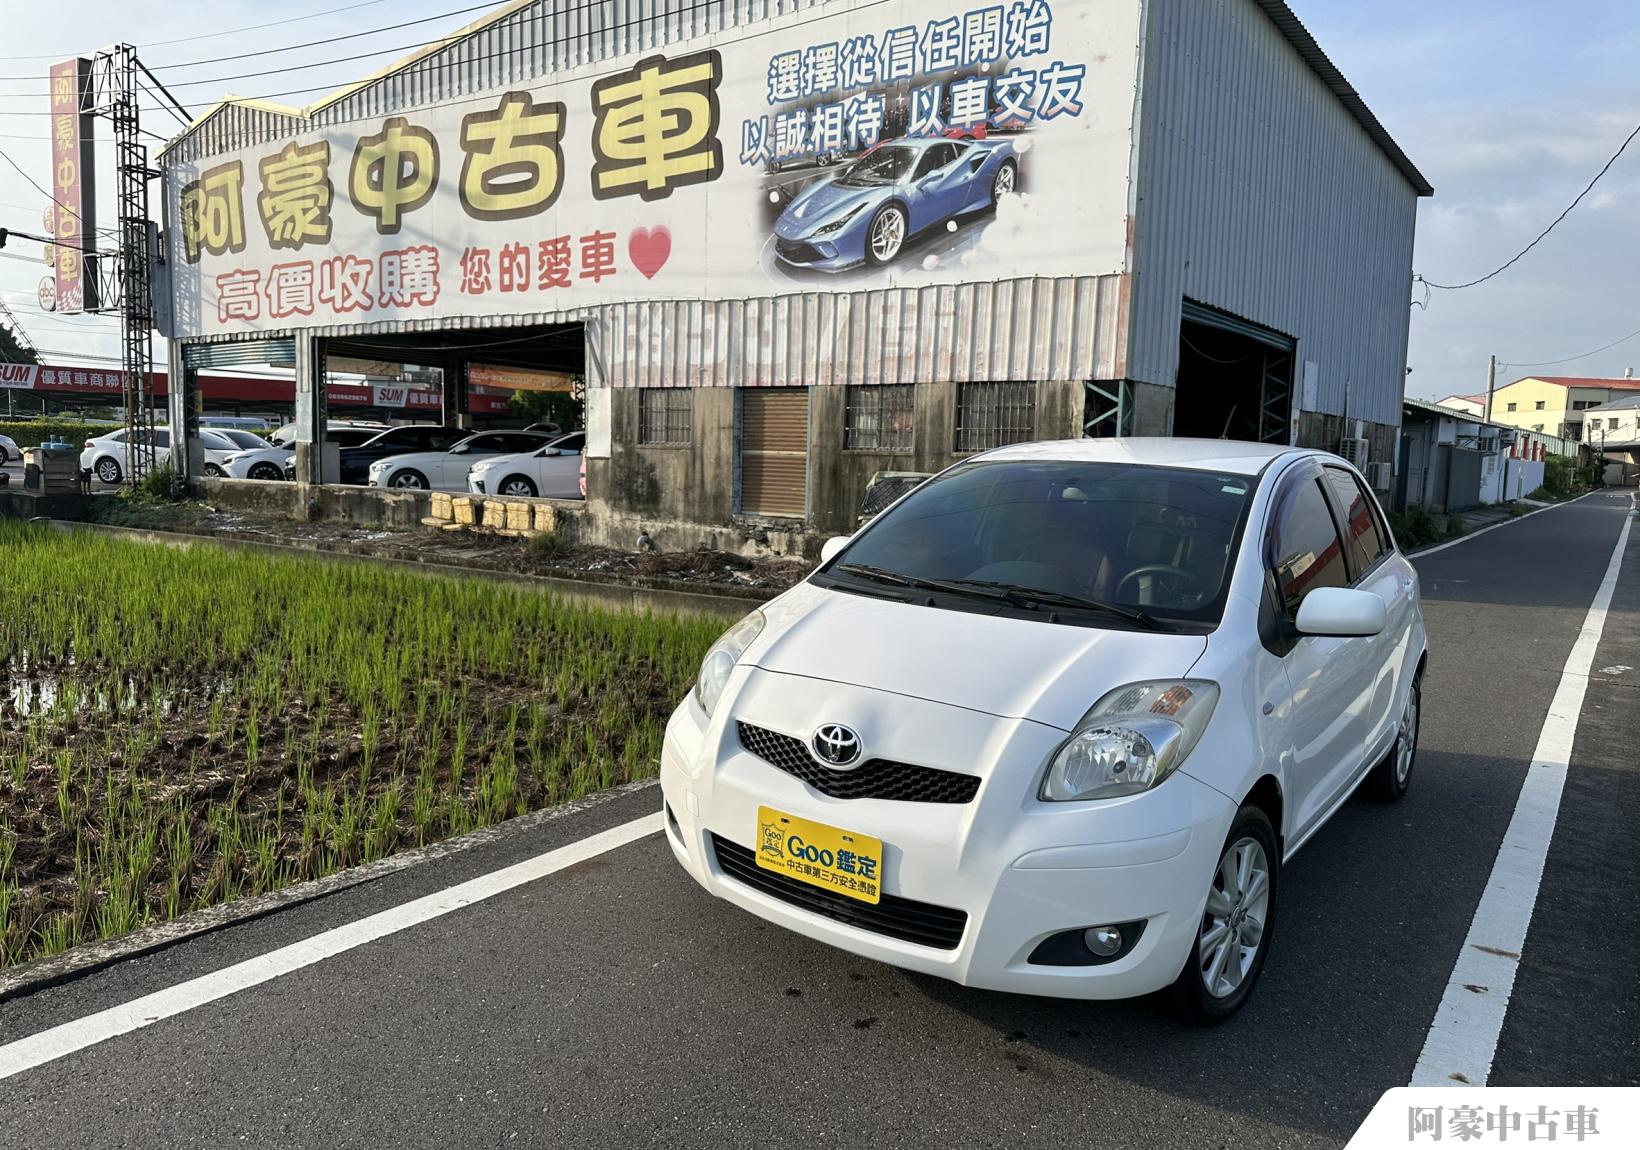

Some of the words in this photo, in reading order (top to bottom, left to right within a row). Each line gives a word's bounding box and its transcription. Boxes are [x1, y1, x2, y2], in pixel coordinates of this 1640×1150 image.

[768, 0, 1053, 104] 選擇從信任開始
[181, 49, 724, 264] 阿豪中古車
[740, 98, 886, 165] 以誠相待
[907, 60, 1086, 138] 以車交友
[55, 69, 79, 282] 阿豪中古車
[216, 245, 441, 323] 高價收購
[459, 230, 617, 295] 您的愛車
[378, 387, 404, 402] SUM
[787, 834, 834, 868] Goo
[836, 848, 877, 881] 鑑定
